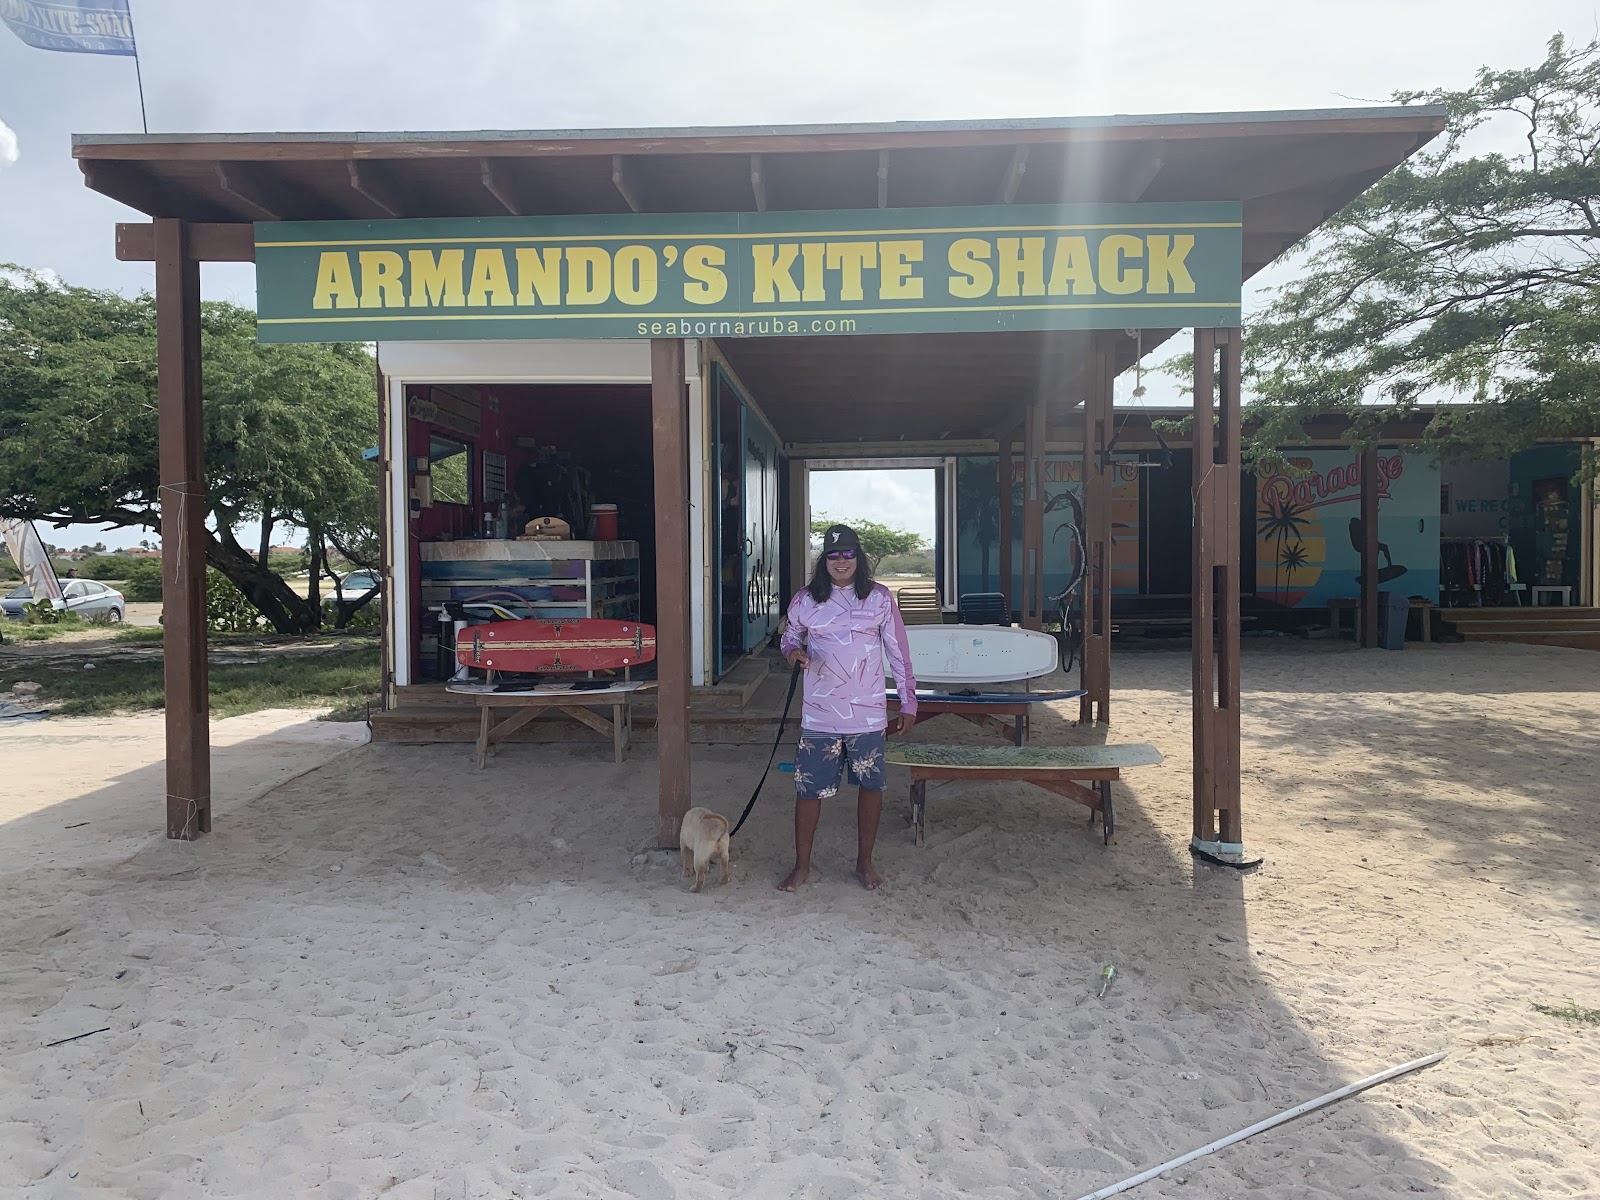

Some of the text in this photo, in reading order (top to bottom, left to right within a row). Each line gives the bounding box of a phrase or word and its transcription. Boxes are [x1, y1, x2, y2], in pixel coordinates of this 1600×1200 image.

[37, 7, 83, 34] KITE
[313, 234, 1196, 310] ARMANDO'S KITE SHACK
[637, 317, 857, 335] seabornaruba.com
[1455, 498, 1498, 513] WE'RE
